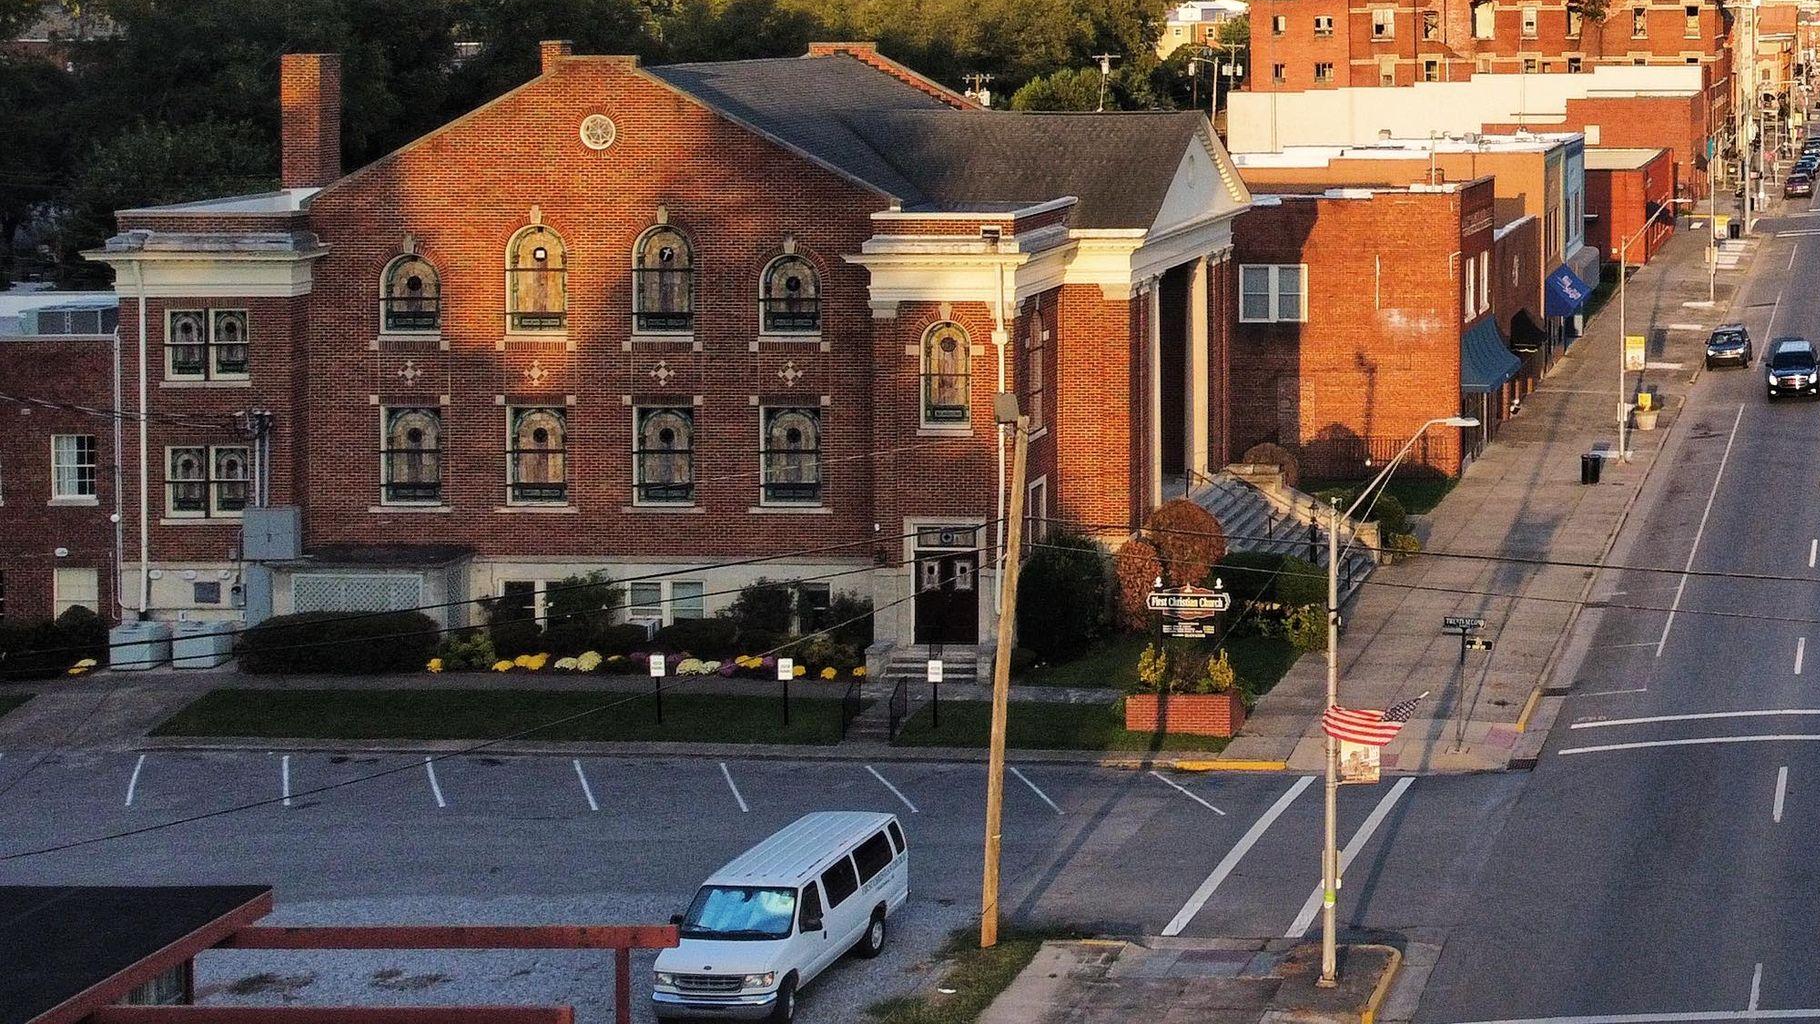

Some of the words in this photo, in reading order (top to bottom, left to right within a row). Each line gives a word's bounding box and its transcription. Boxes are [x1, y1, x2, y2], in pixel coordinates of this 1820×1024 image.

[1151, 596, 1168, 606] First
[1168, 596, 1198, 607] Christian
[1199, 597, 1223, 607] Church
